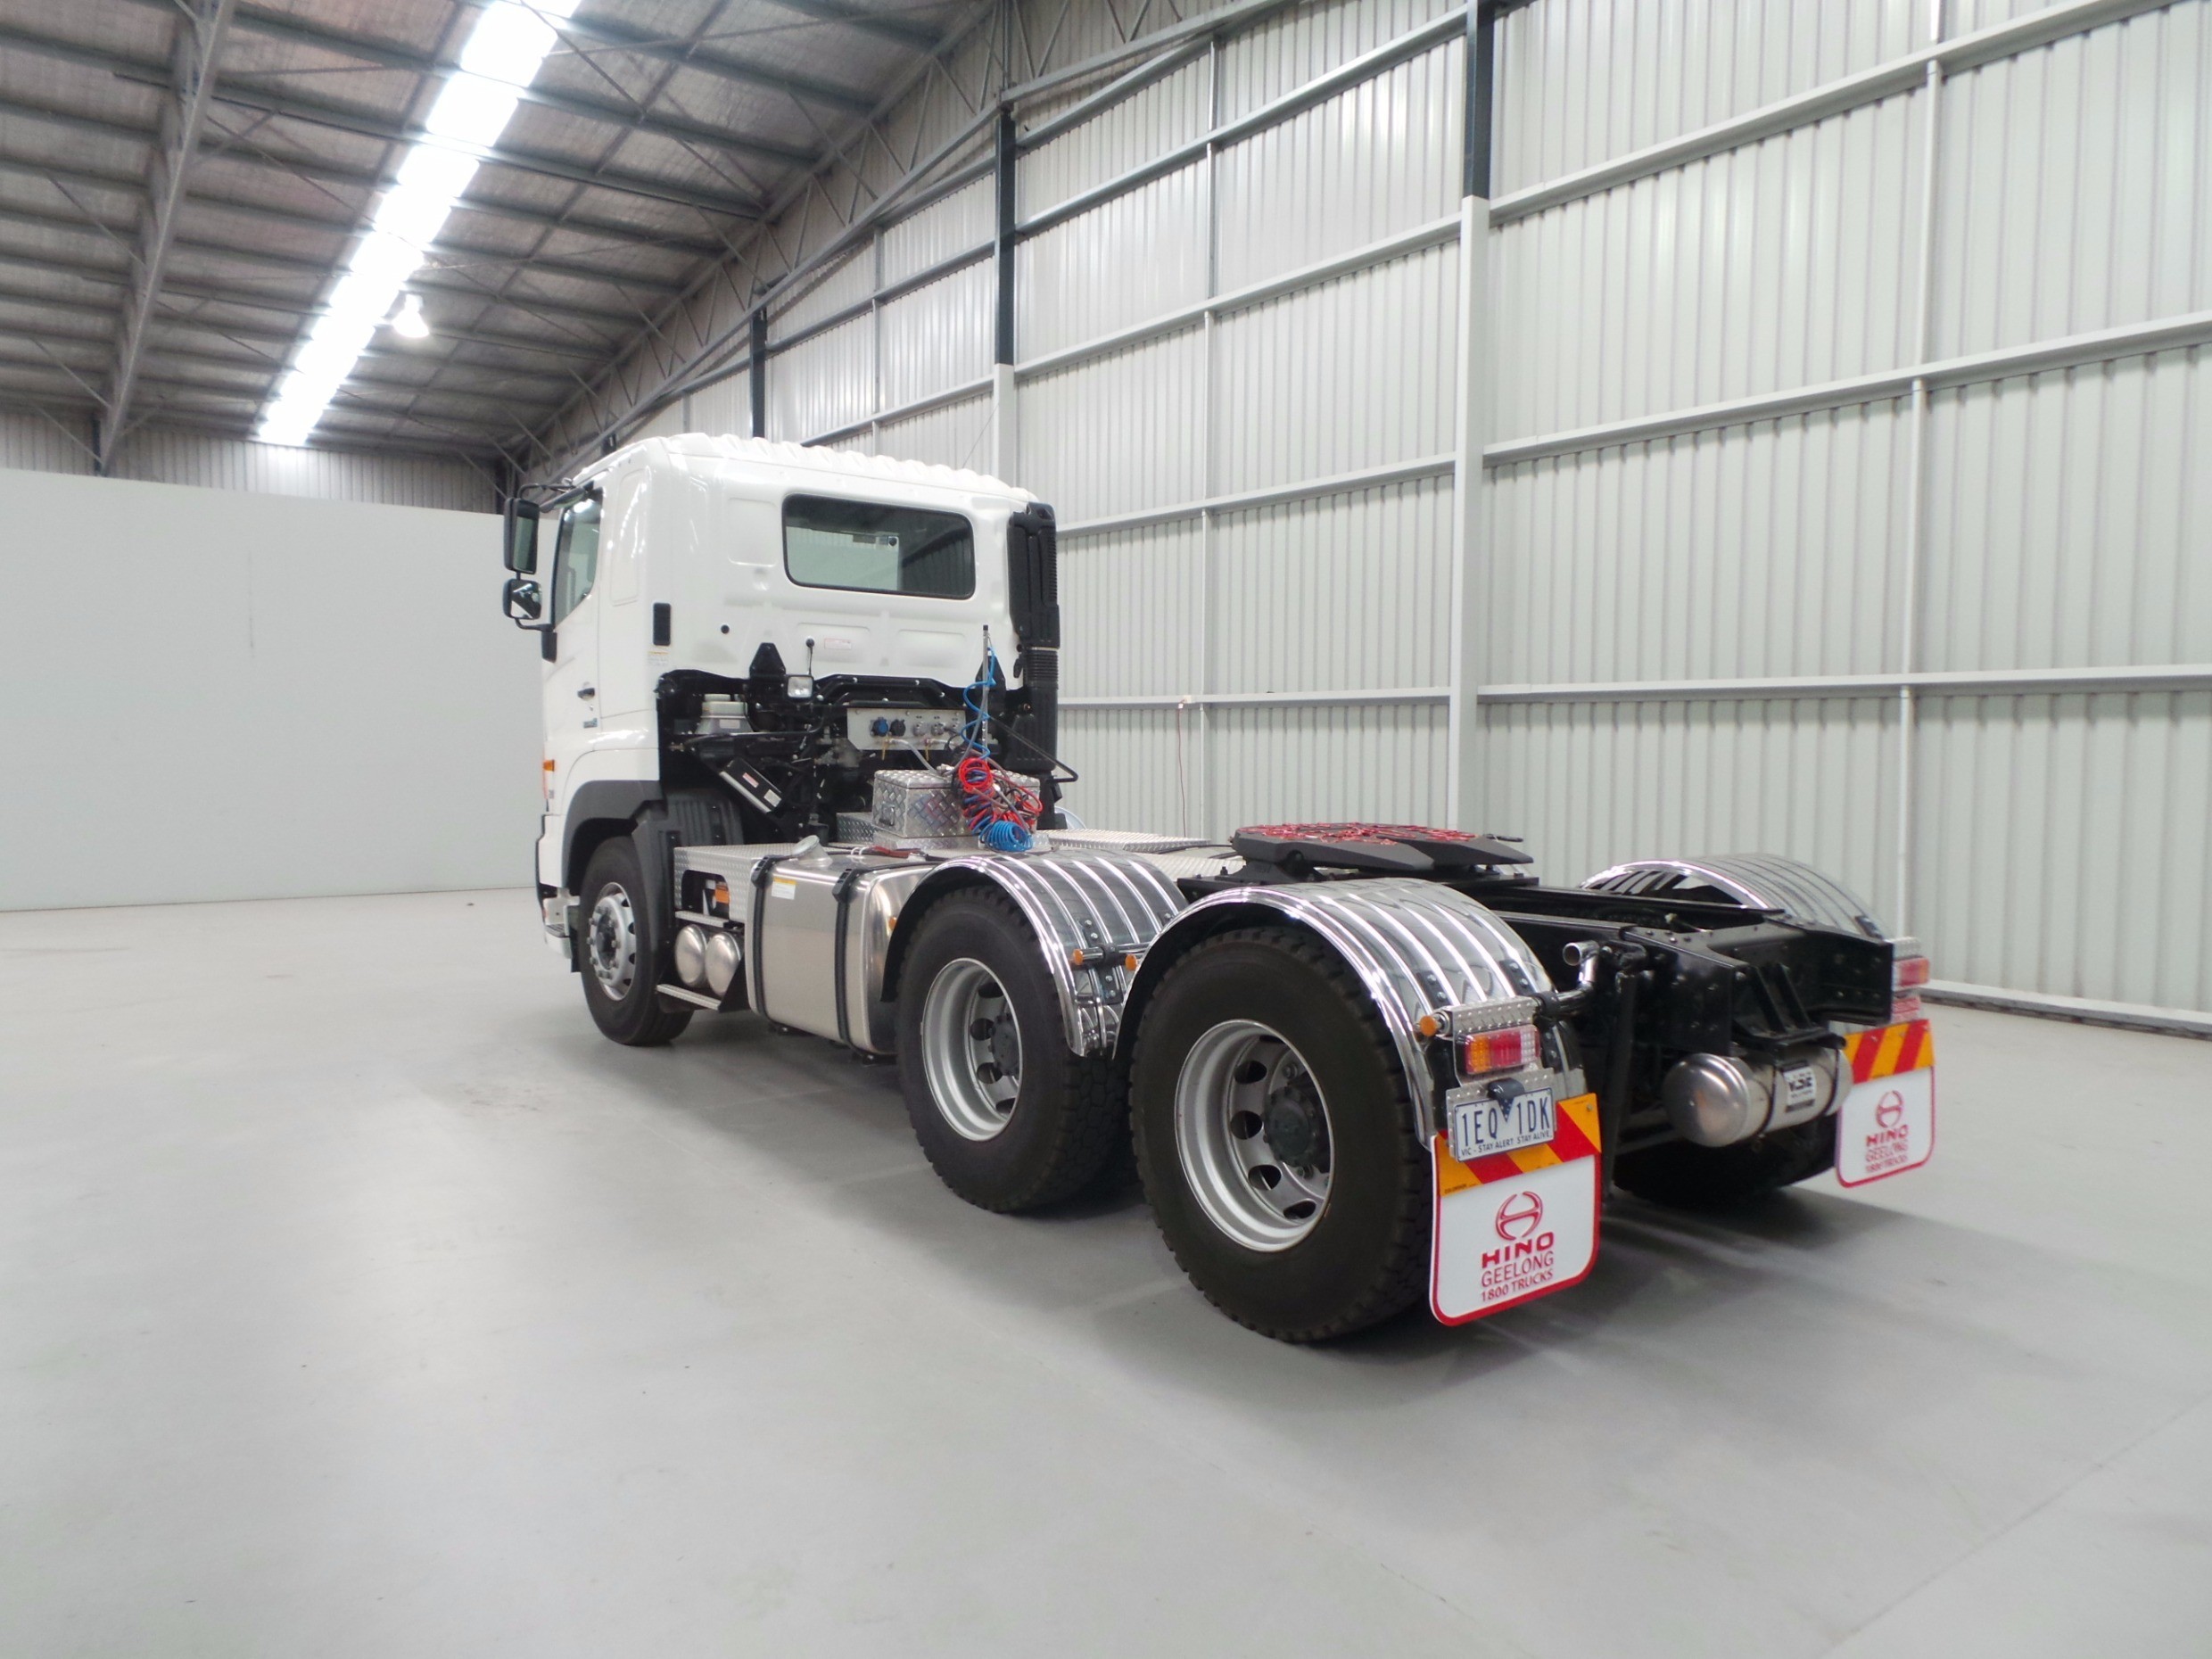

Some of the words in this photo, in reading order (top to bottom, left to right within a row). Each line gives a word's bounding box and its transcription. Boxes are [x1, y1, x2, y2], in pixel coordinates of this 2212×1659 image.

[1462, 1107, 1498, 1147] 1EQ
[1516, 1096, 1550, 1135] 1DK
[1866, 1124, 1909, 1147] HINO
[1461, 1147, 1472, 1156] VIC
[1478, 1143, 1493, 1153] STAY
[1495, 1137, 1514, 1149] ALERT
[1517, 1135, 1531, 1144] STAY
[1482, 1232, 1554, 1269] HINO
[1482, 1250, 1554, 1288] GEELONG
[1482, 1283, 1509, 1301] 1800
[1511, 1268, 1554, 1292] TRUCKS
